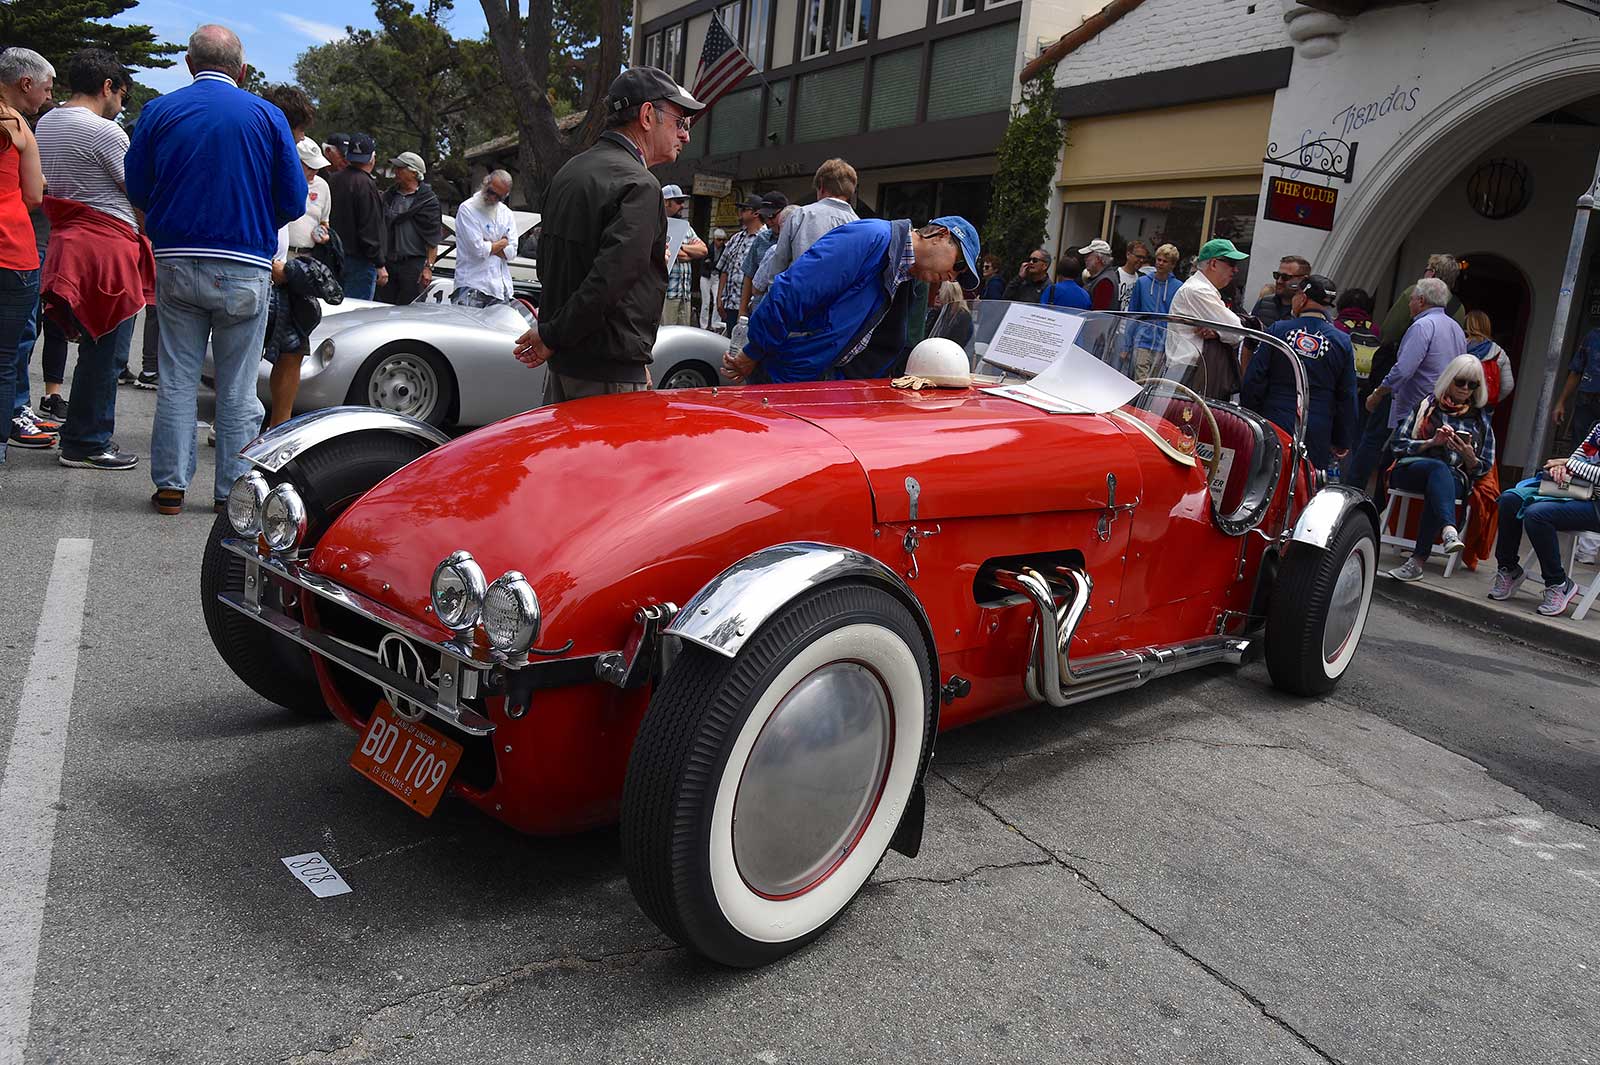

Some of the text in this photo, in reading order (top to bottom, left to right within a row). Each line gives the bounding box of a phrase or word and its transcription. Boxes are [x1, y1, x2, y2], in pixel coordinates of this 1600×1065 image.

[1275, 180, 1335, 203] THE CLUB
[396, 719, 437, 746] LAND OF LINCOLN
[361, 717, 446, 794] BD 1709
[381, 772, 405, 790] ILLINOIS
